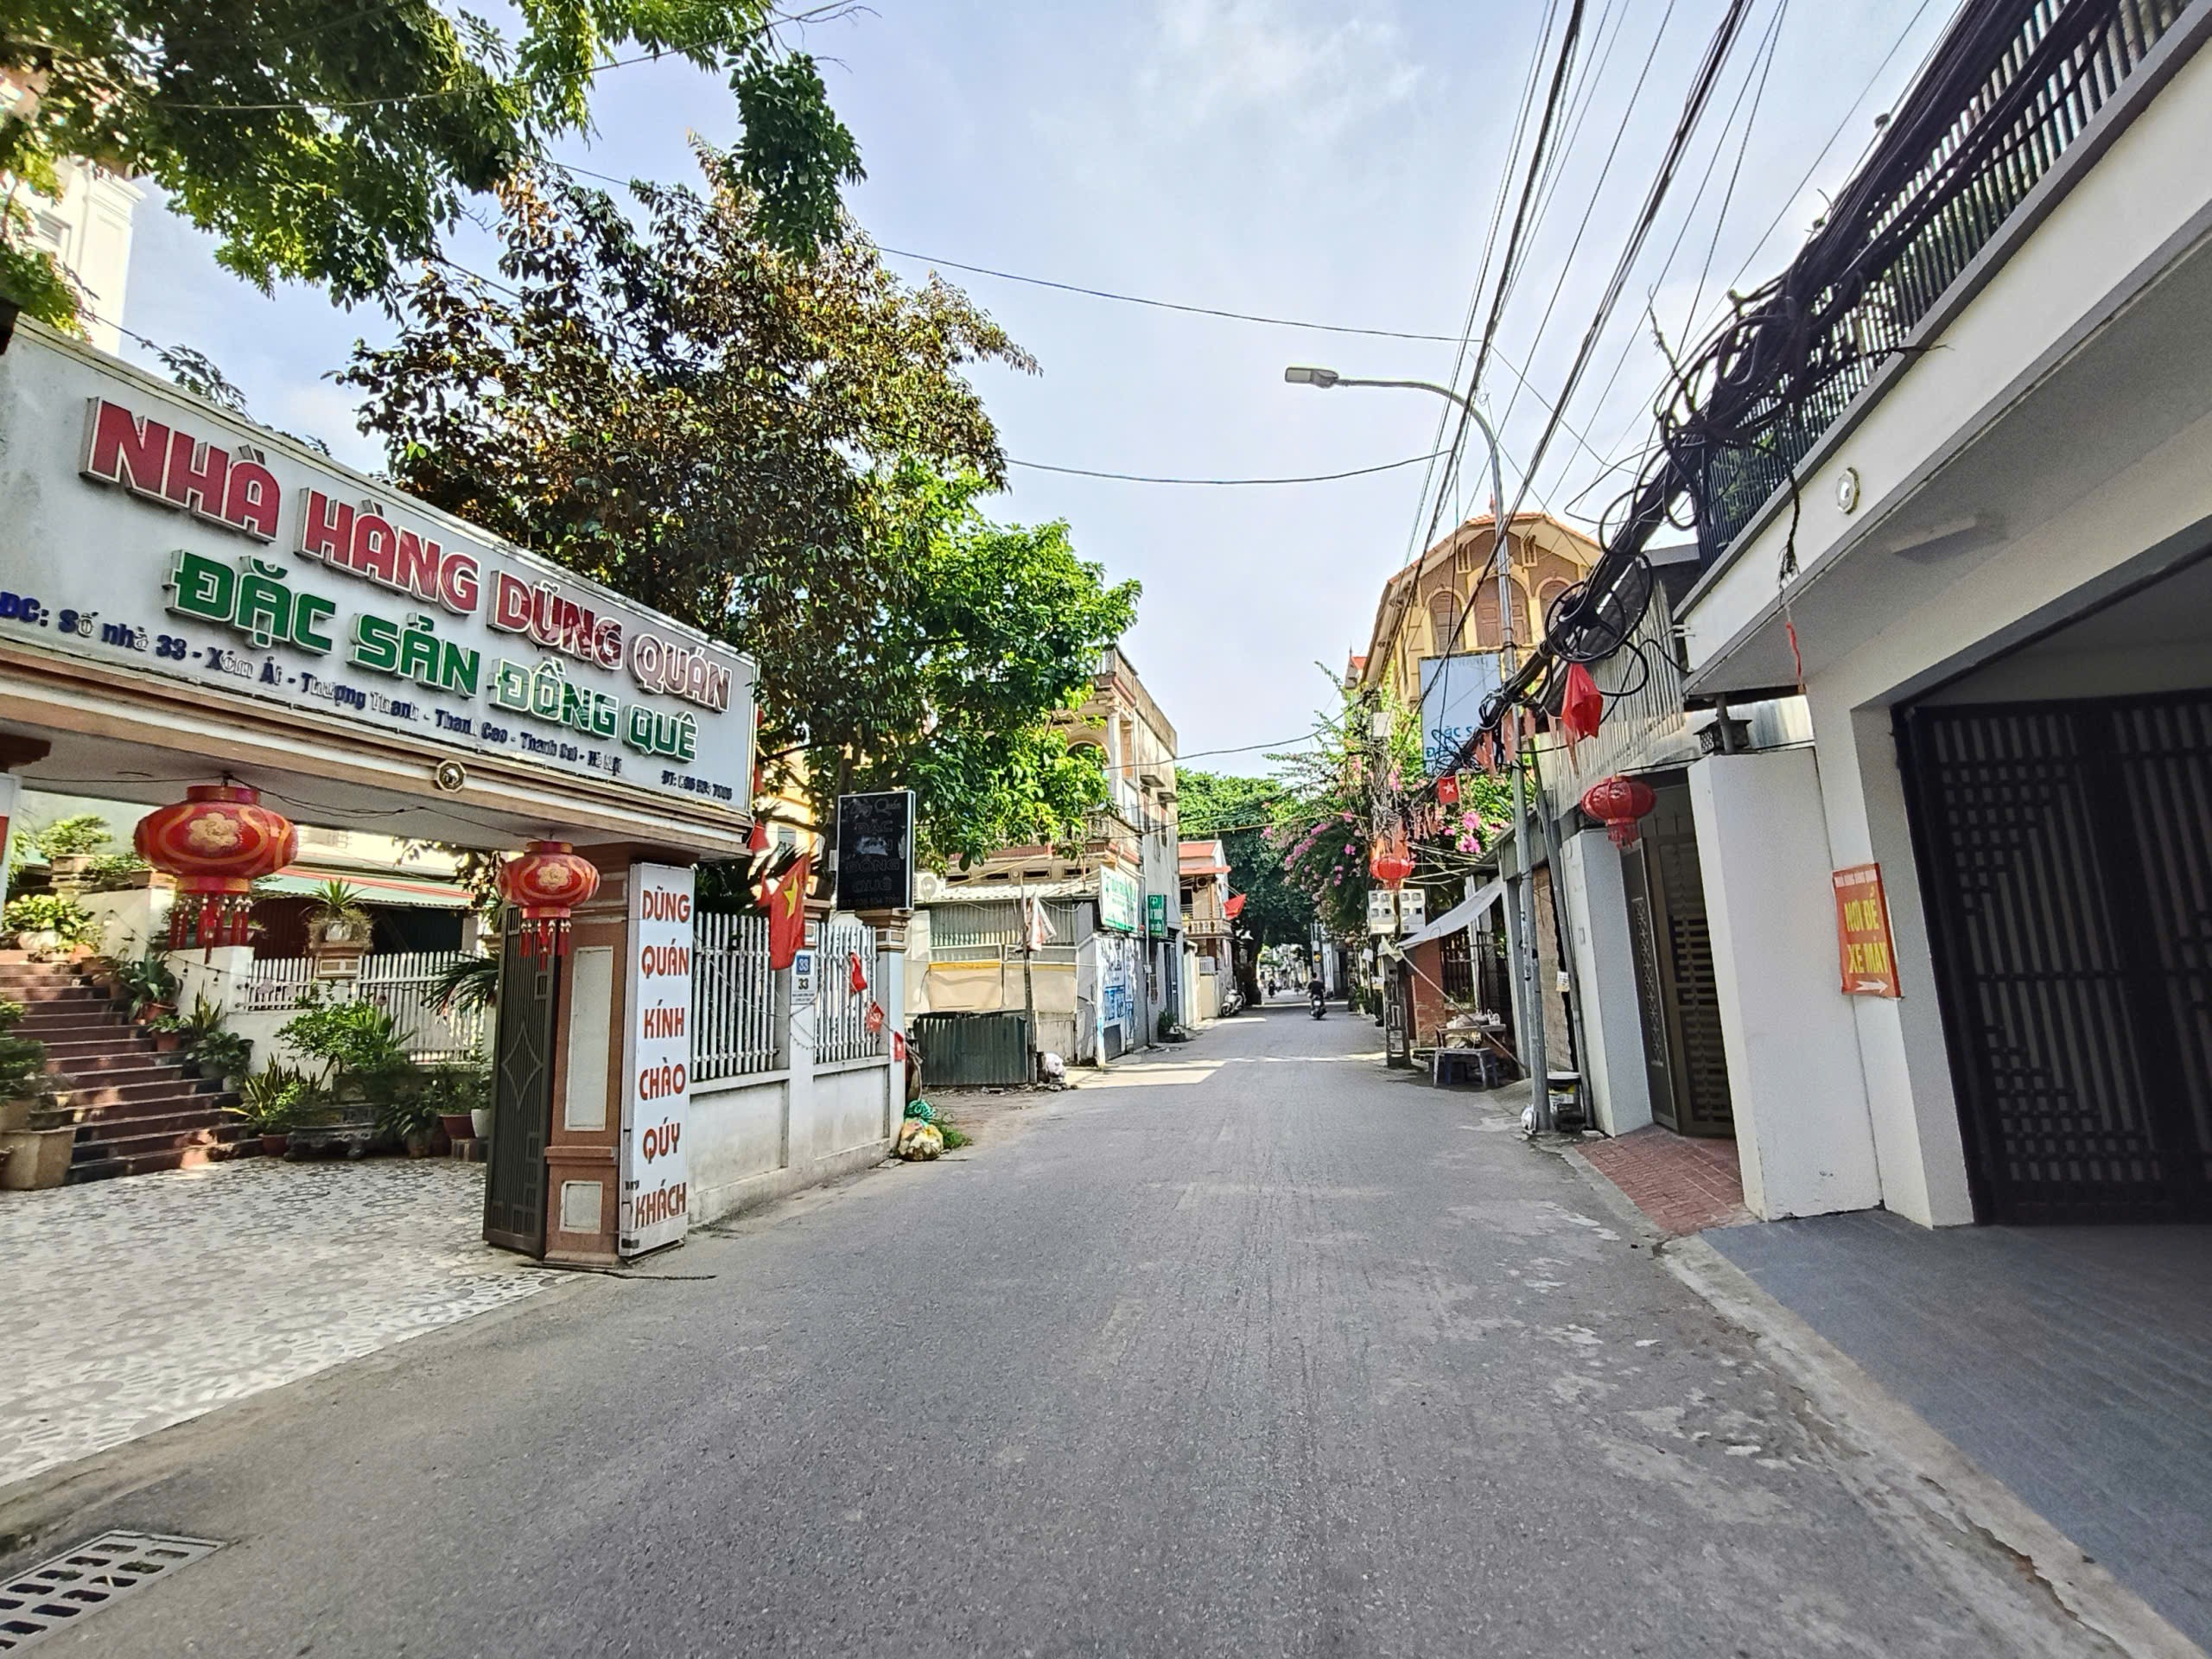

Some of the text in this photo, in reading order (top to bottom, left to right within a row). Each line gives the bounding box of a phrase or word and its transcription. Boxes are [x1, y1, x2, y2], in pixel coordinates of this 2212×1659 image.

[81, 397, 733, 713] NHÀ HÀNG DŨNG QUÁN
[58, 609, 99, 638] Số
[101, 621, 149, 652] nhà
[156, 634, 188, 661] 33
[205, 646, 253, 679] Xóm
[371, 690, 420, 721] Thanh
[164, 549, 698, 763] ĐẶC SẢN ĐỒNG QUÊ
[642, 886, 690, 924] DŨNG
[641, 938, 690, 979] QUÁN
[1847, 936, 1888, 974] XE MÁY
[798, 978, 809, 990] 33
[643, 1000, 685, 1039] KÍNH
[639, 1057, 686, 1101] CHÀO
[642, 1116, 681, 1164] QÚY
[634, 1179, 687, 1230] KHÁCH
